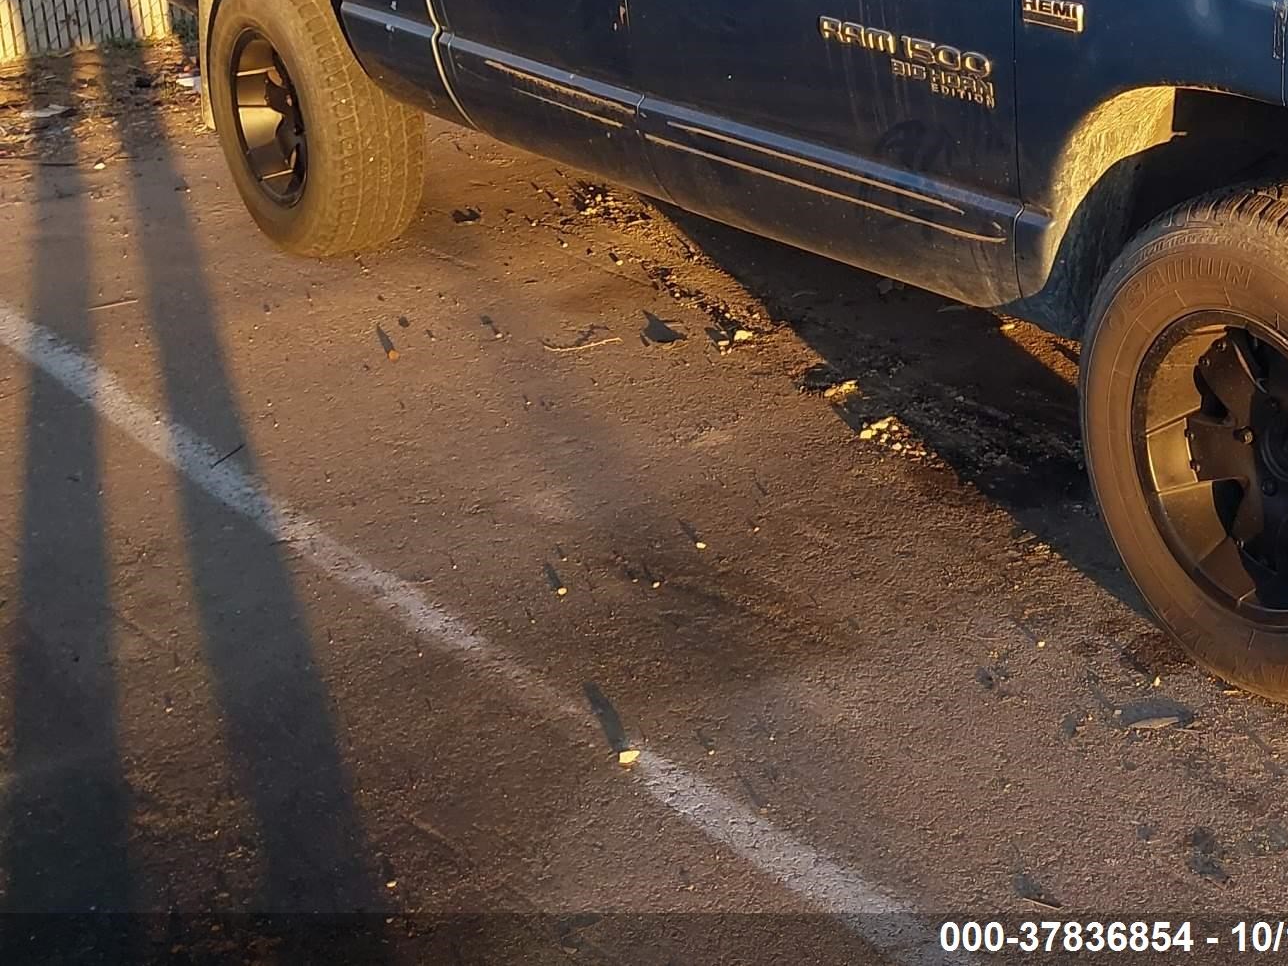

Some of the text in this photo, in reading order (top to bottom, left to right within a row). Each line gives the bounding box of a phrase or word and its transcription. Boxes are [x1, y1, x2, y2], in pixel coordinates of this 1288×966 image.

[818, 15, 993, 80] RAM 1500
[890, 58, 995, 98] BIG HORN
[930, 84, 996, 109] EDITION
